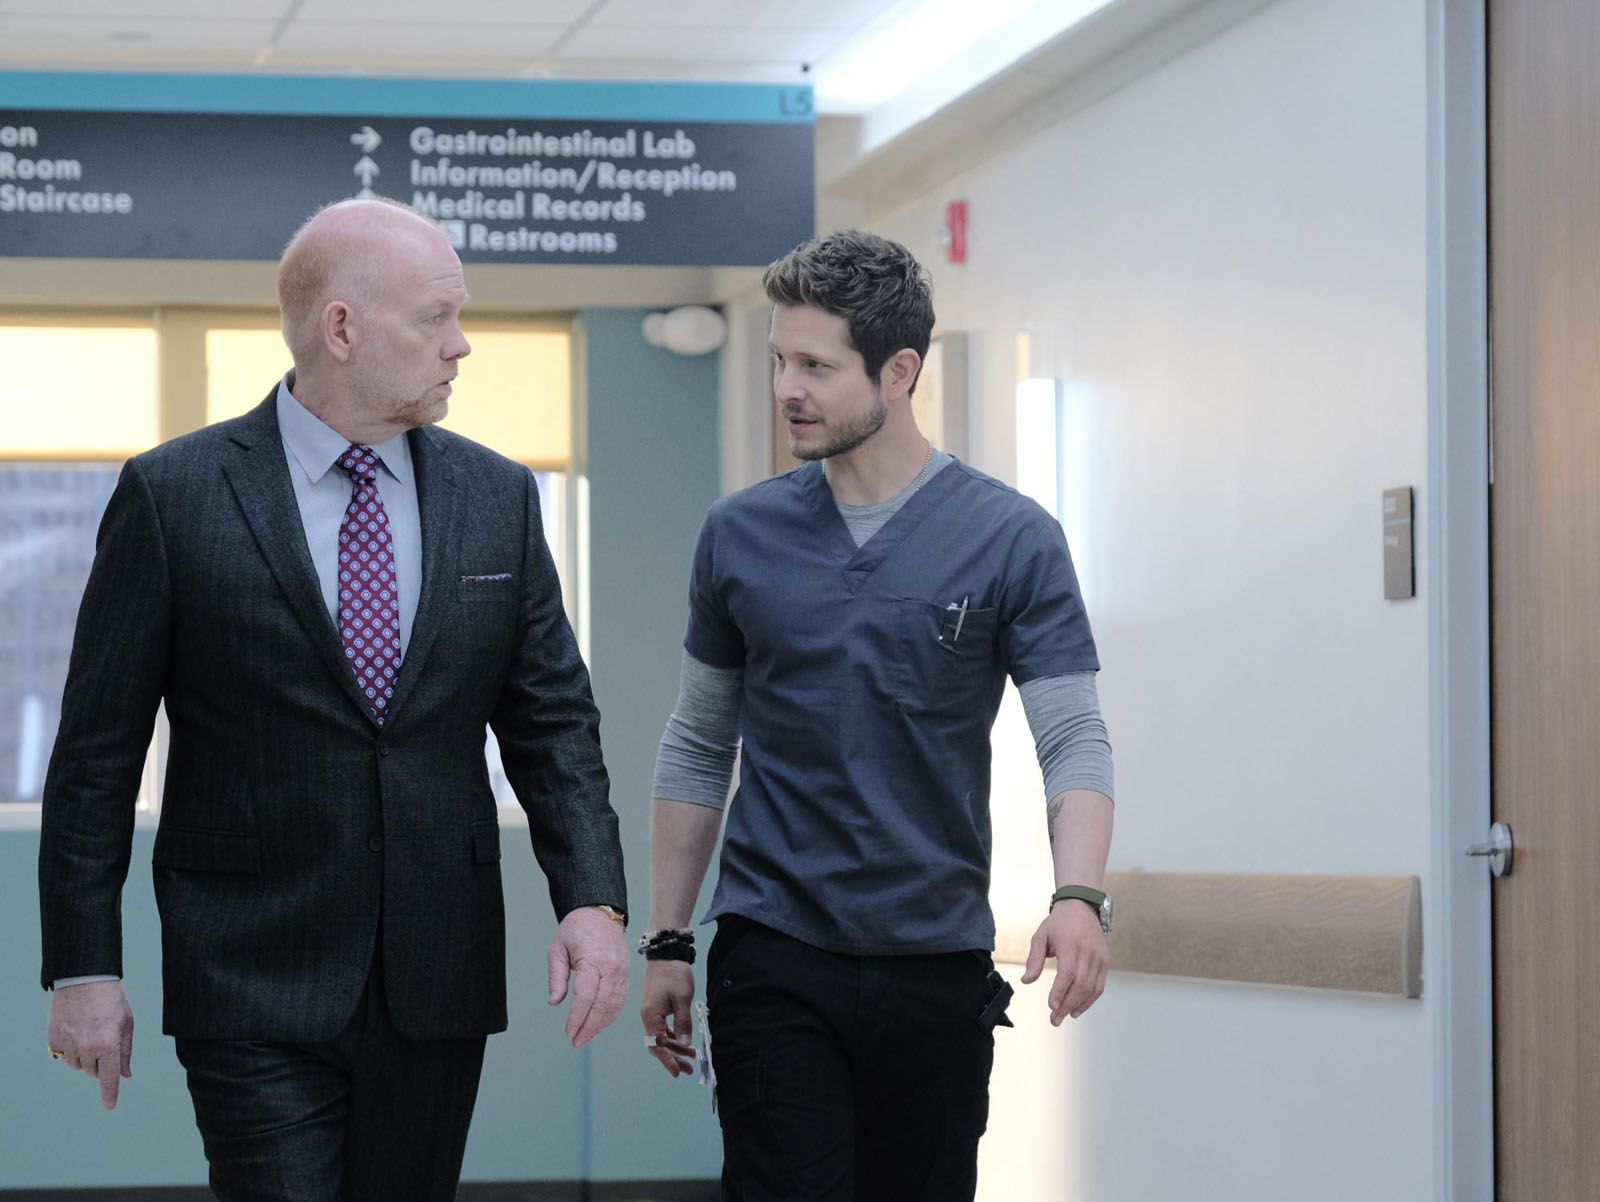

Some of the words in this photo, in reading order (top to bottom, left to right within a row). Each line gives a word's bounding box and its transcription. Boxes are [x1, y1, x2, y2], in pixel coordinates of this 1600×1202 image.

[0, 126, 38, 147] on
[410, 126, 636, 157] Gastrointestinal
[643, 129, 696, 158] Lab
[0, 151, 82, 180] Room
[410, 157, 737, 196] Information/Reception
[0, 184, 133, 214] Staircase
[411, 190, 525, 220] Medical
[532, 192, 646, 221] Records
[469, 223, 618, 252] Restrooms
